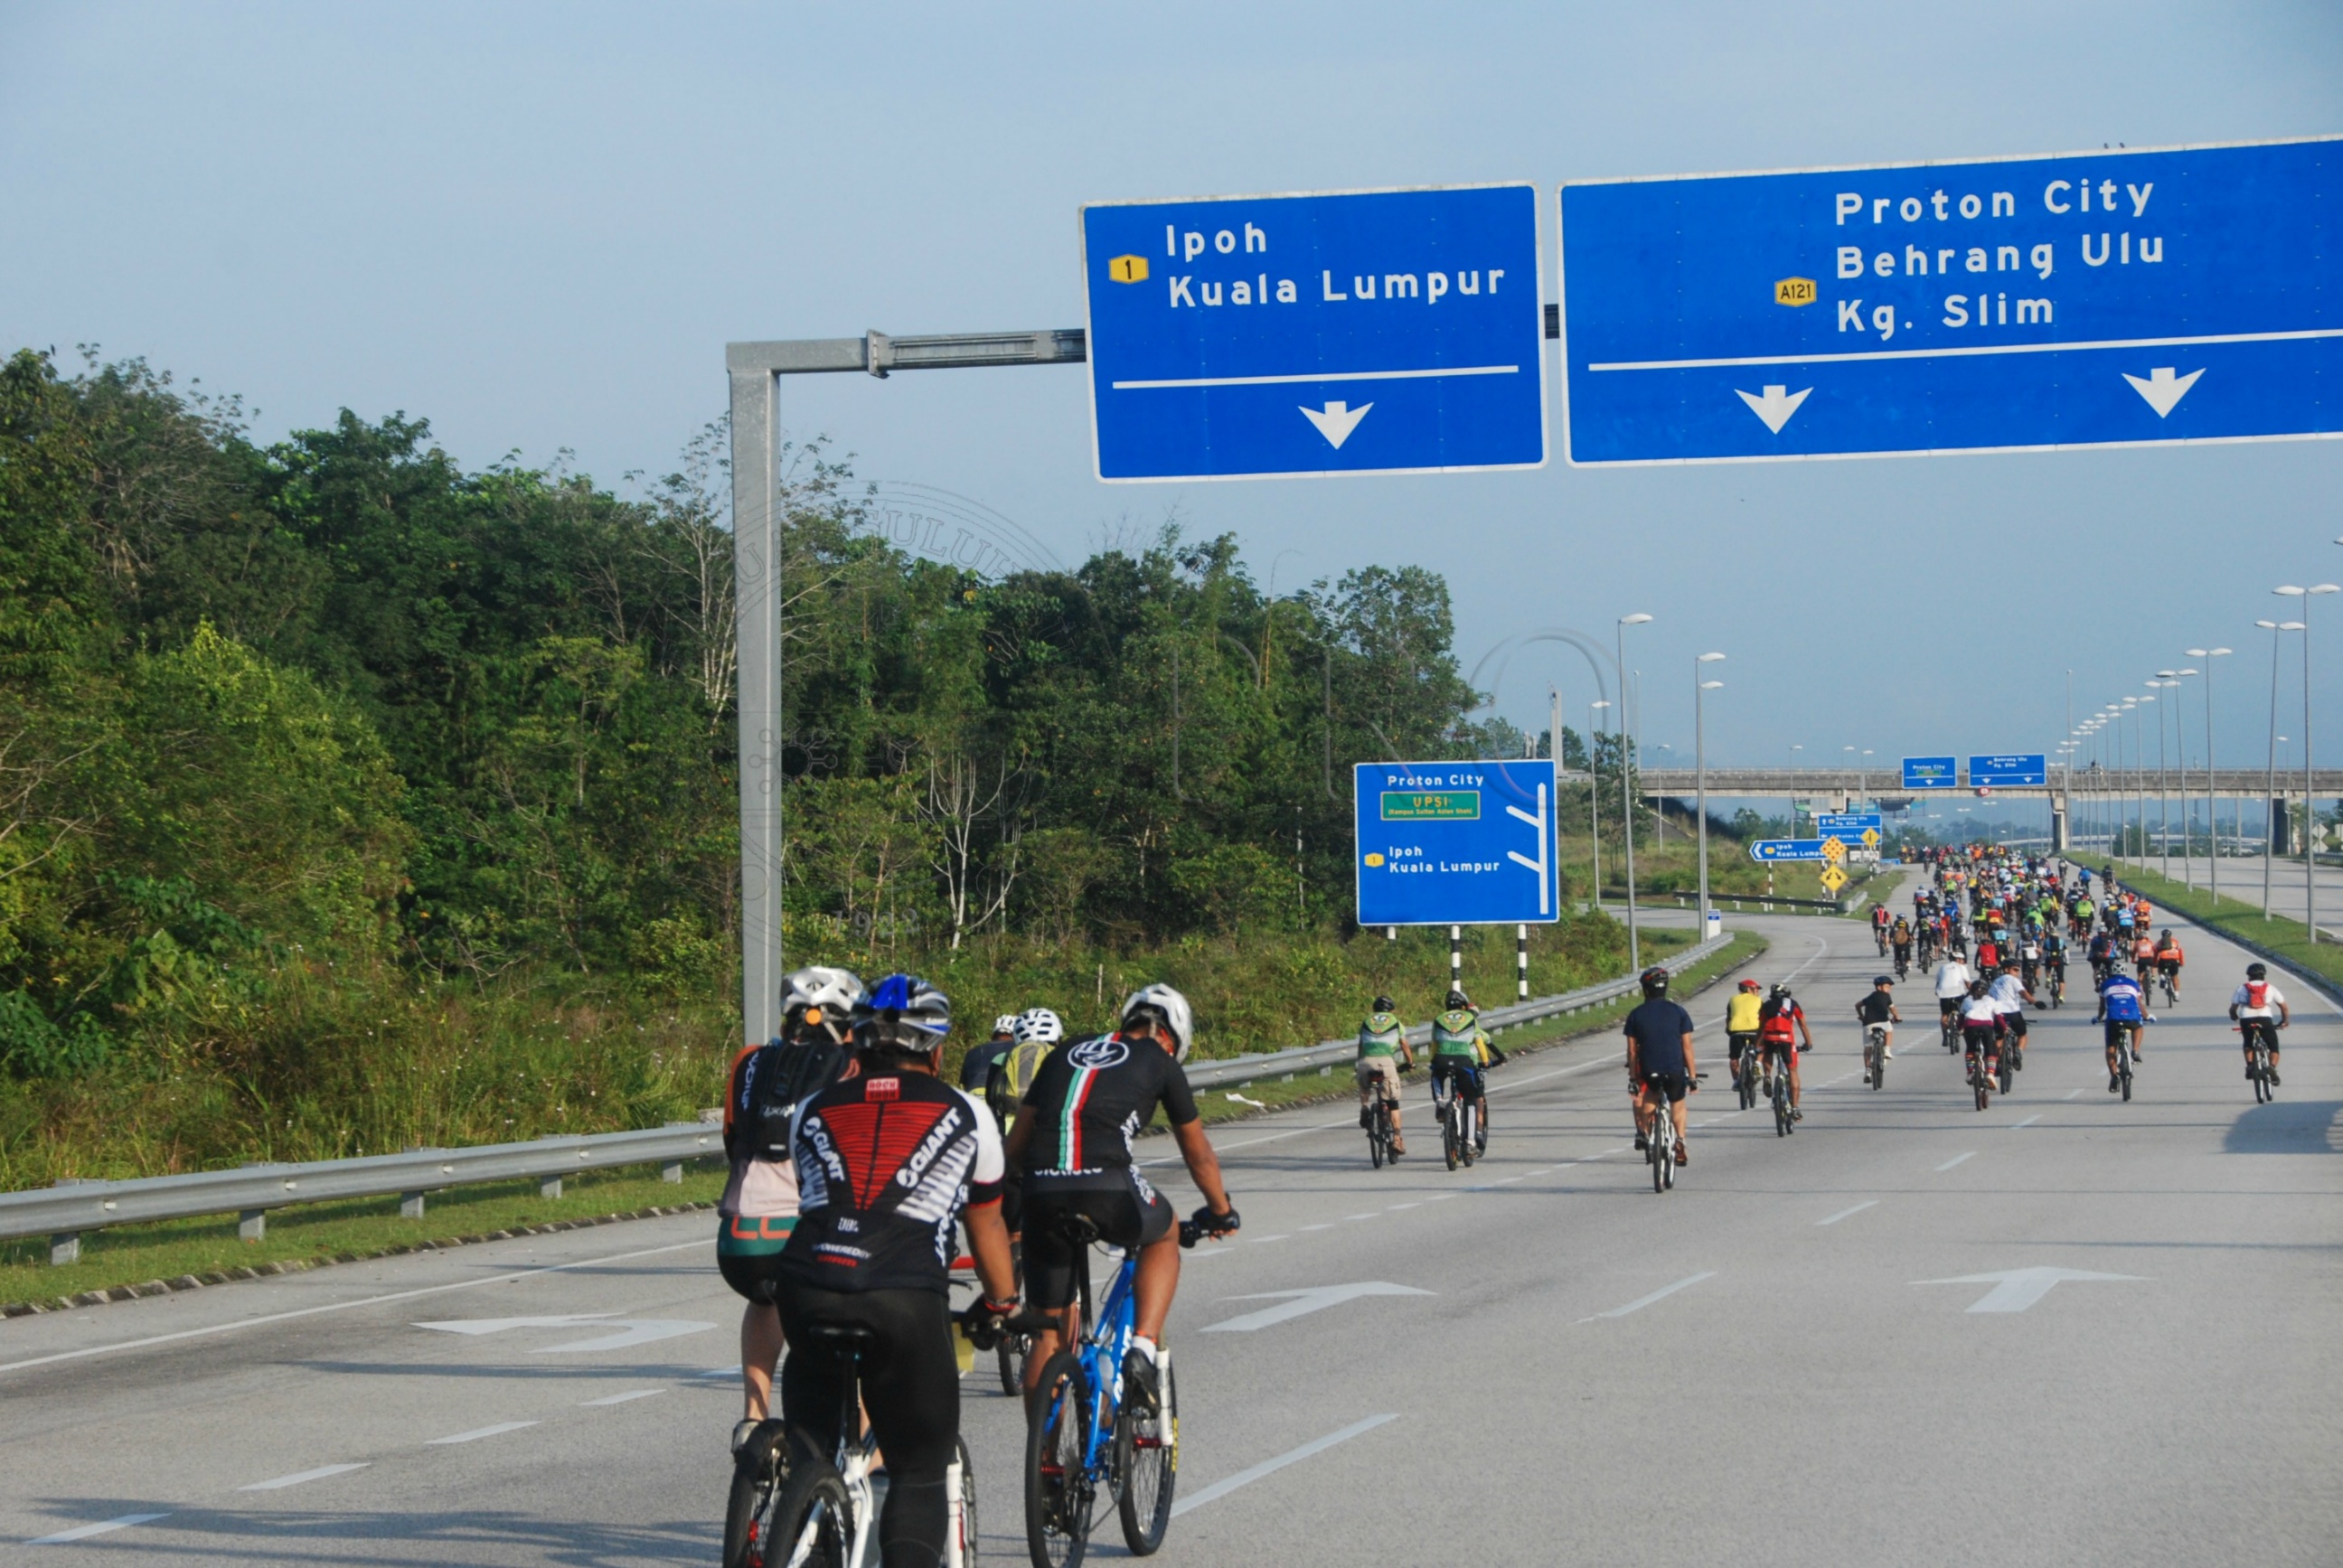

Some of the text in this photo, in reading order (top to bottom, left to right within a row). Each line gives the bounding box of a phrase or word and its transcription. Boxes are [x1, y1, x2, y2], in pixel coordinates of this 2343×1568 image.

[1836, 178, 2154, 226] Proton City
[1166, 221, 1266, 263] Ipoh
[1837, 231, 2163, 280] Behrang Ulu
[1124, 259, 1133, 280] 1
[1169, 269, 1505, 308] Kuala Lumpur
[1780, 284, 1811, 300] A121
[1838, 292, 2054, 341] Kg. Slim
[1388, 774, 1484, 787] Proton City
[1413, 796, 1448, 808] UPSI
[1389, 846, 1423, 859] Ipoh
[1389, 860, 1501, 874] Kuala Lumpur
[814, 1131, 846, 1182] GIANT
[909, 1107, 962, 1173] GIANT
